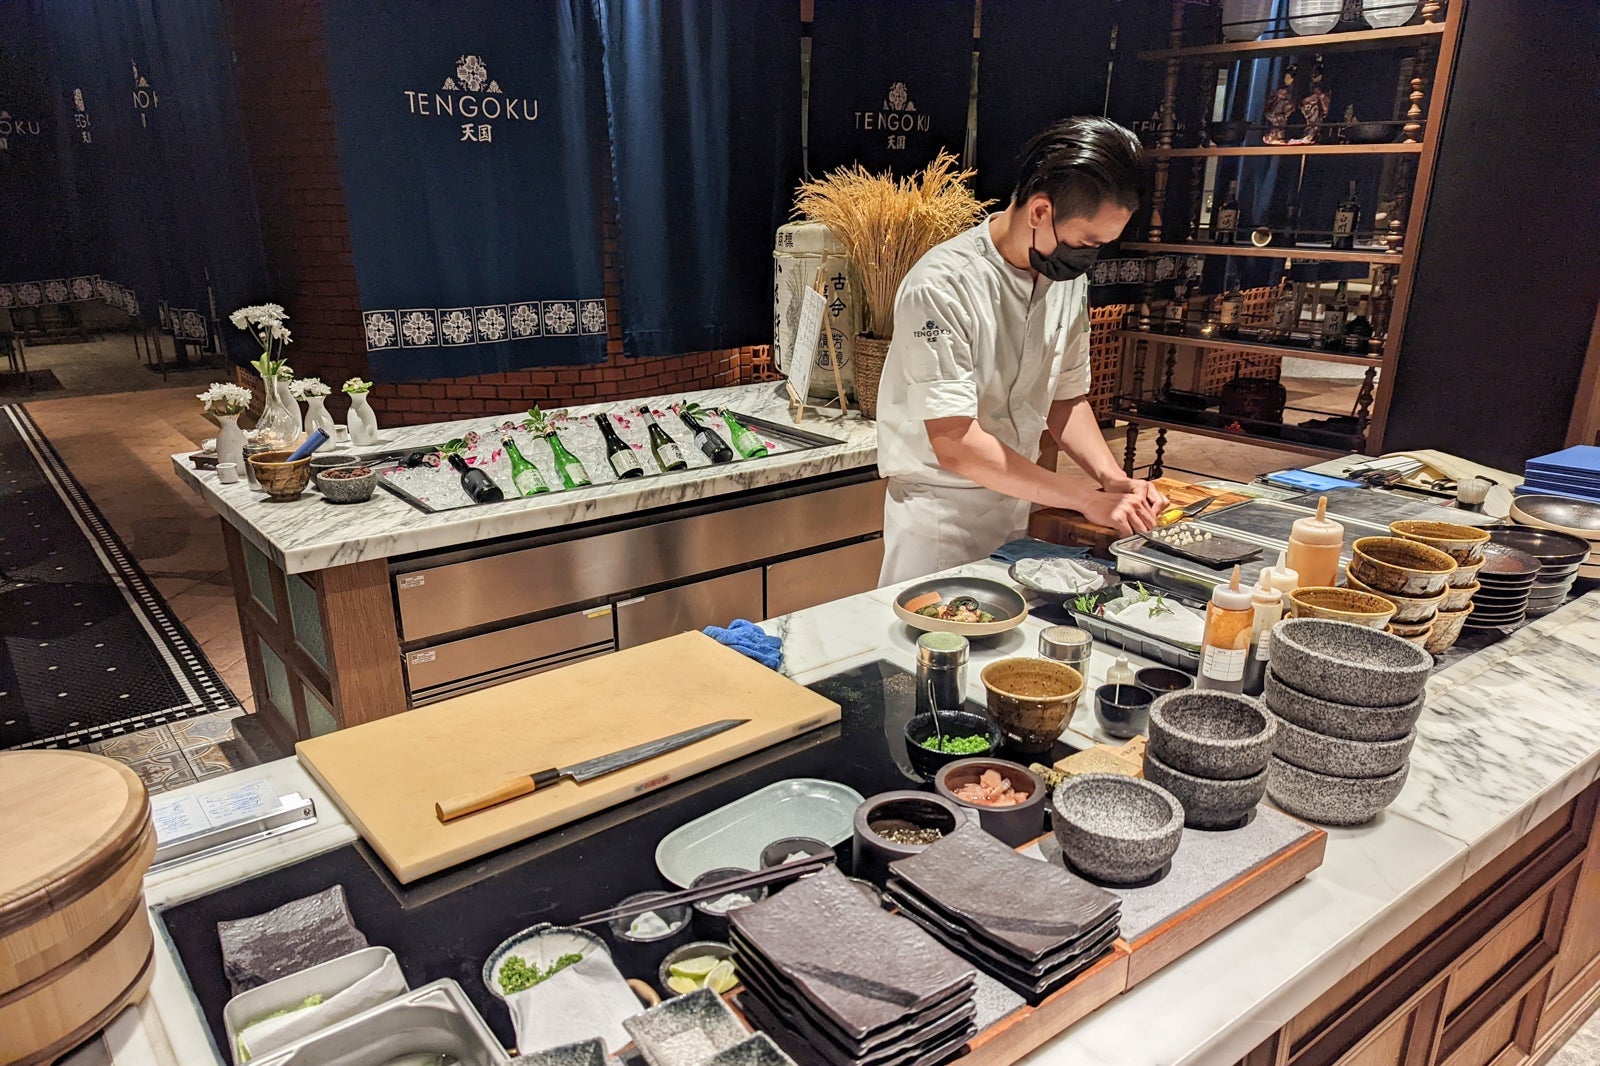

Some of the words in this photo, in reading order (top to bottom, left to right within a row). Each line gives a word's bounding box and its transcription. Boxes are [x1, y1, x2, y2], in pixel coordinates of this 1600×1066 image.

[404, 91, 538, 120] TENGOKU
[854, 111, 931, 132] TENGOKU
[460, 123, 492, 142] 天国
[887, 134, 906, 150] 天国
[829, 272, 847, 318] 古今
[913, 329, 951, 338] TENGOKU
